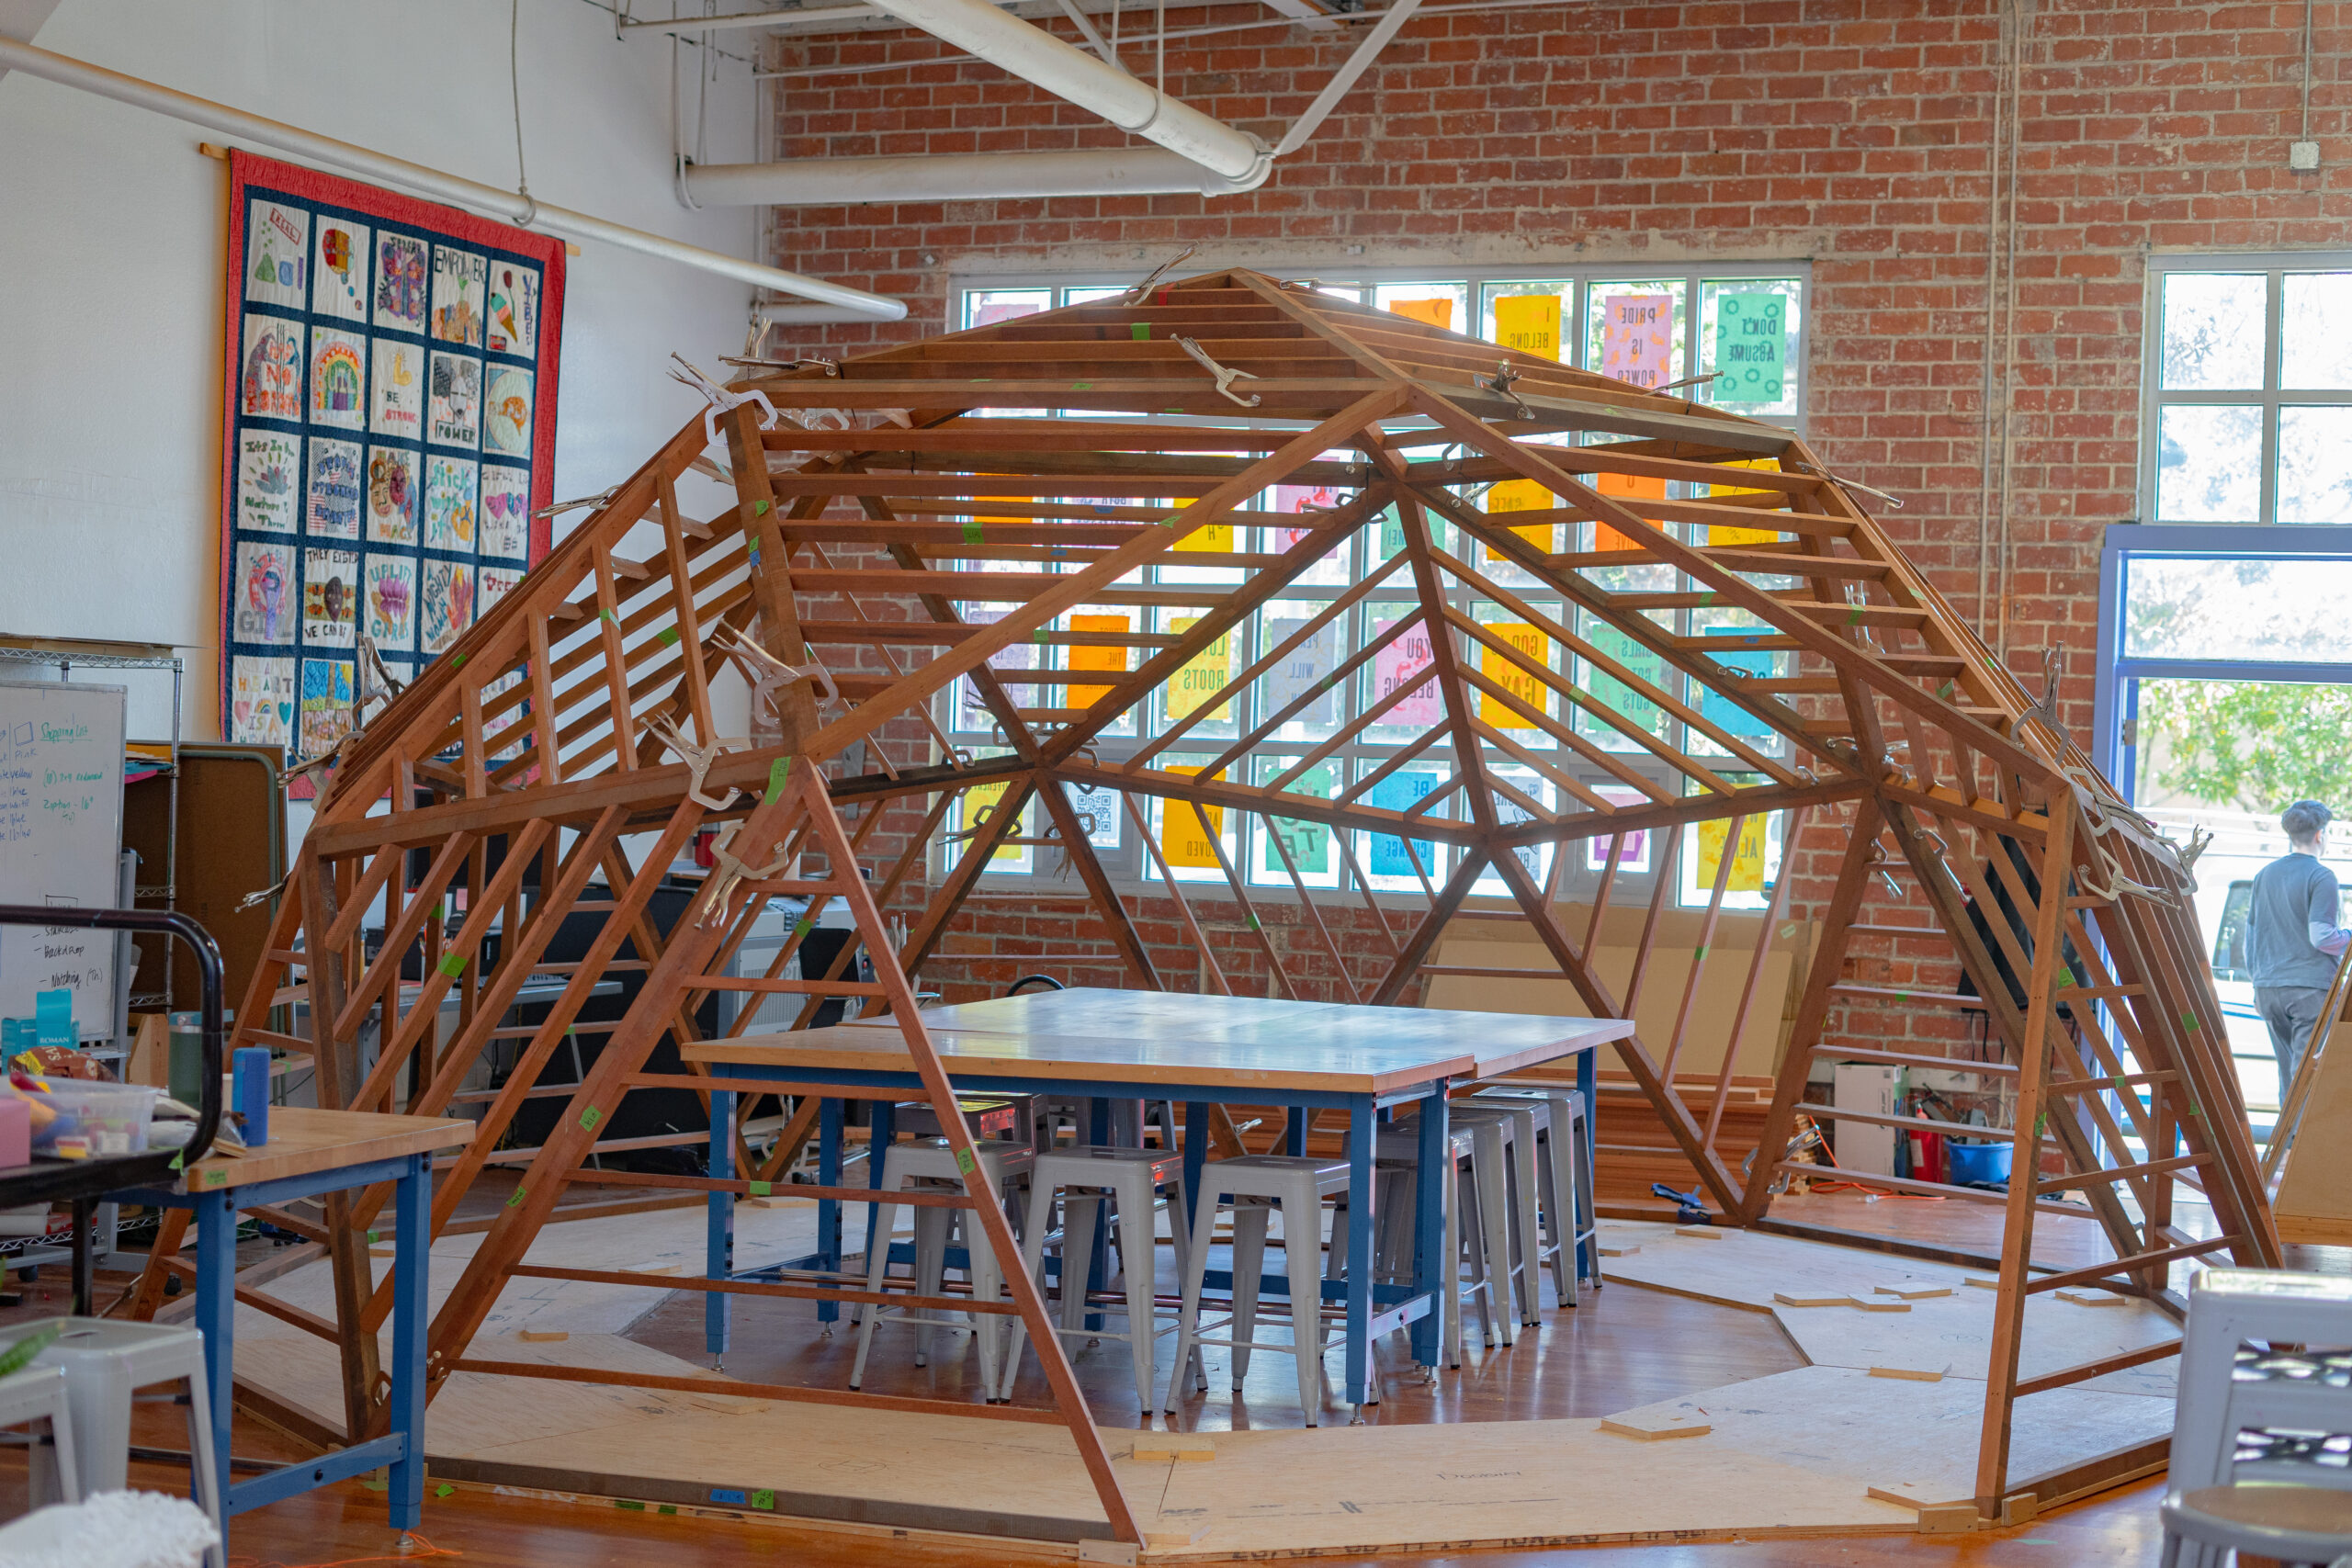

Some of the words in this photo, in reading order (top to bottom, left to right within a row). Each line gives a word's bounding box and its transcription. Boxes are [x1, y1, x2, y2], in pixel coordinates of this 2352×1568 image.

[386, 391, 400, 403] BE
[385, 409, 417, 424] STRONG
[438, 424, 475, 444] POWER
[433, 463, 469, 491] Stick
[306, 550, 330, 563] THEY
[305, 625, 318, 638] WE
[322, 624, 337, 636] CAN
[237, 676, 293, 694] HEART
[248, 715, 264, 731] IS
[40, 1036, 70, 1045] ROMAN
